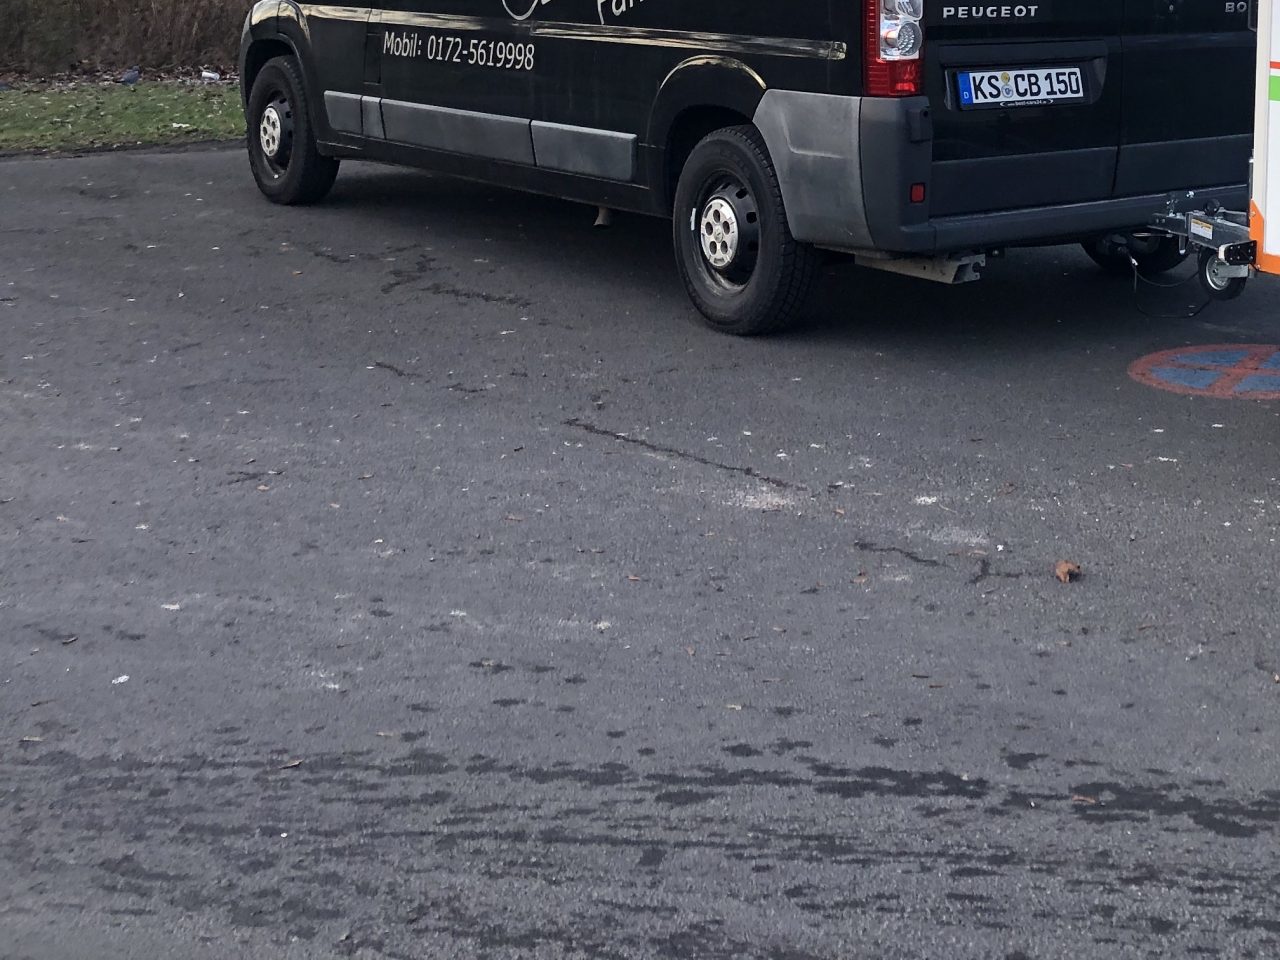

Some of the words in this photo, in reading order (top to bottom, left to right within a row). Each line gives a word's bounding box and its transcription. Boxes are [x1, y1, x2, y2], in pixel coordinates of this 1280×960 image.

[942, 5, 1038, 19] PEUGEOT
[383, 30, 422, 58] Mobil:
[427, 34, 535, 71] 0172-5619998
[972, 75, 1001, 100] KS
[1013, 73, 1042, 98] CB
[1044, 71, 1081, 96] 150
